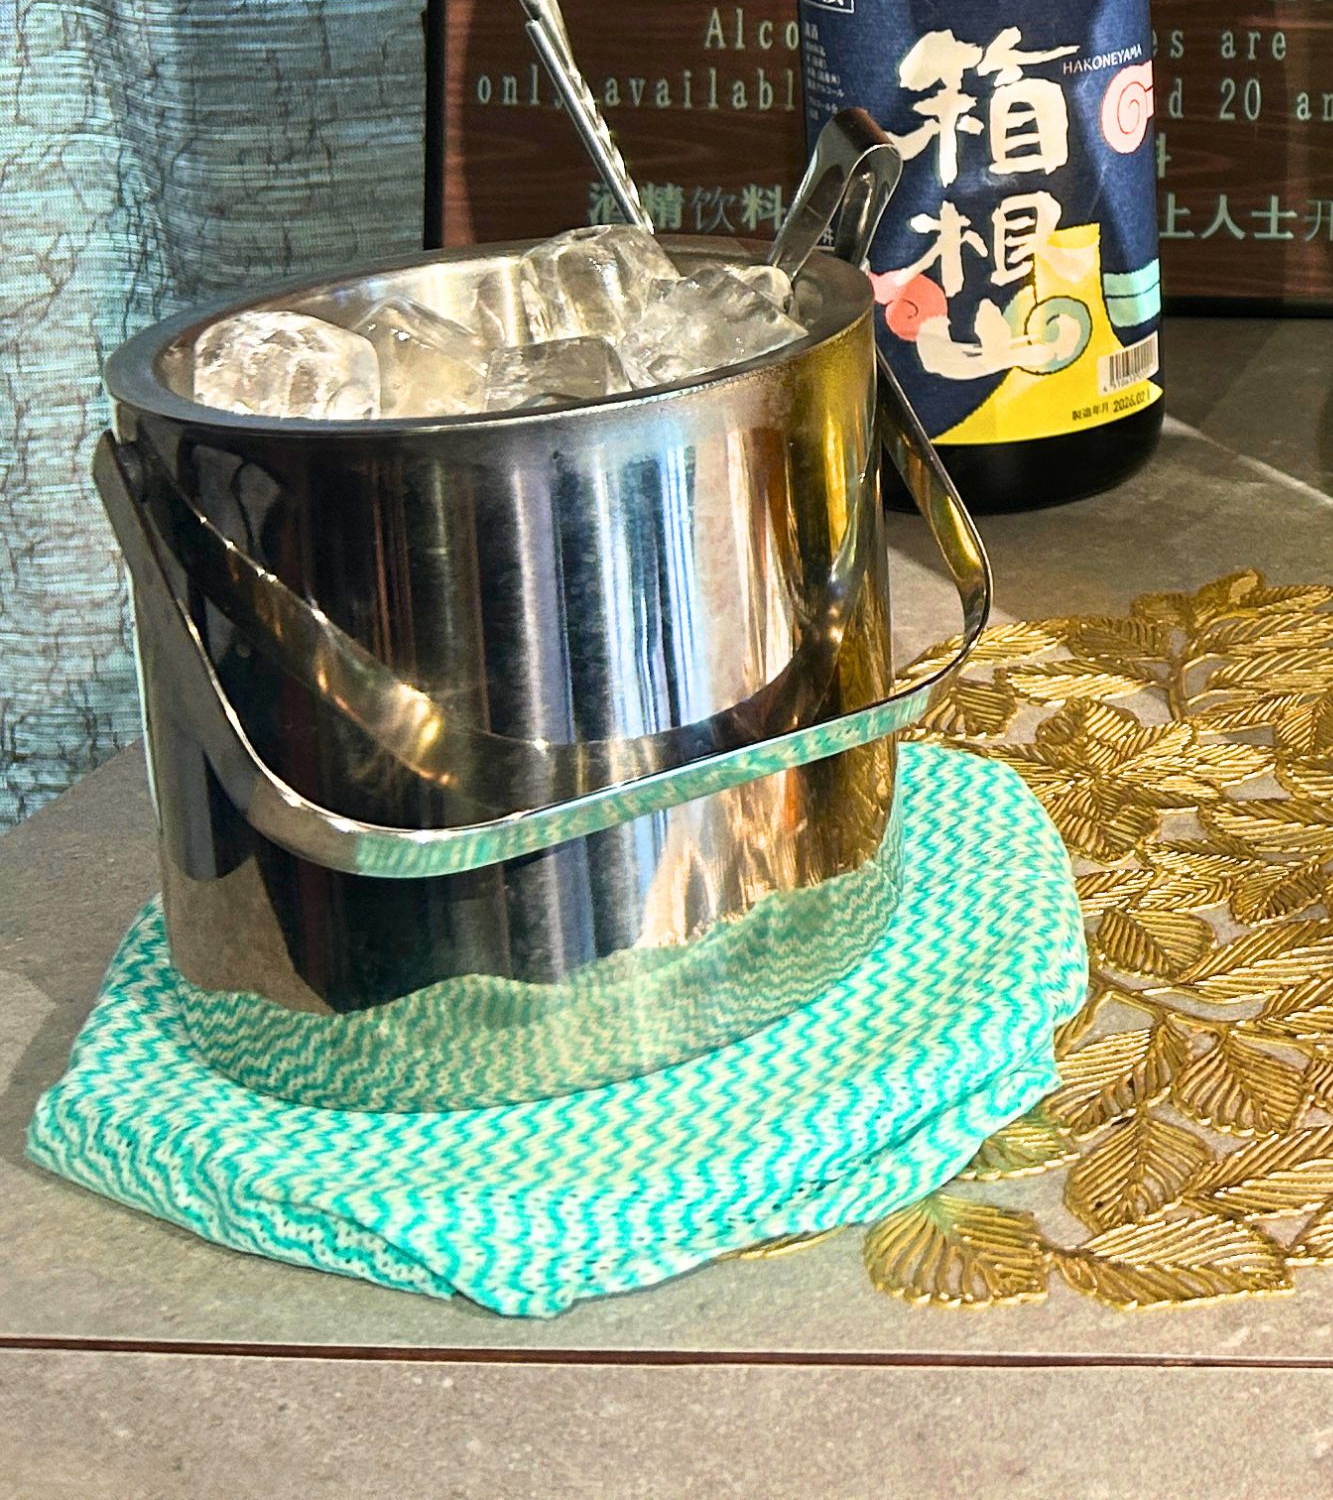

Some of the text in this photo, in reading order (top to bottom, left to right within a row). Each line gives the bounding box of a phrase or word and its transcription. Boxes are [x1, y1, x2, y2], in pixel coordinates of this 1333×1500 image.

[1062, 43, 1143, 75] HAKONEYAMA
[1221, 29, 1288, 61] are
[603, 67, 796, 112] availabl
[1219, 78, 1262, 121] 20
[886, 25, 1084, 381] 箱根山
